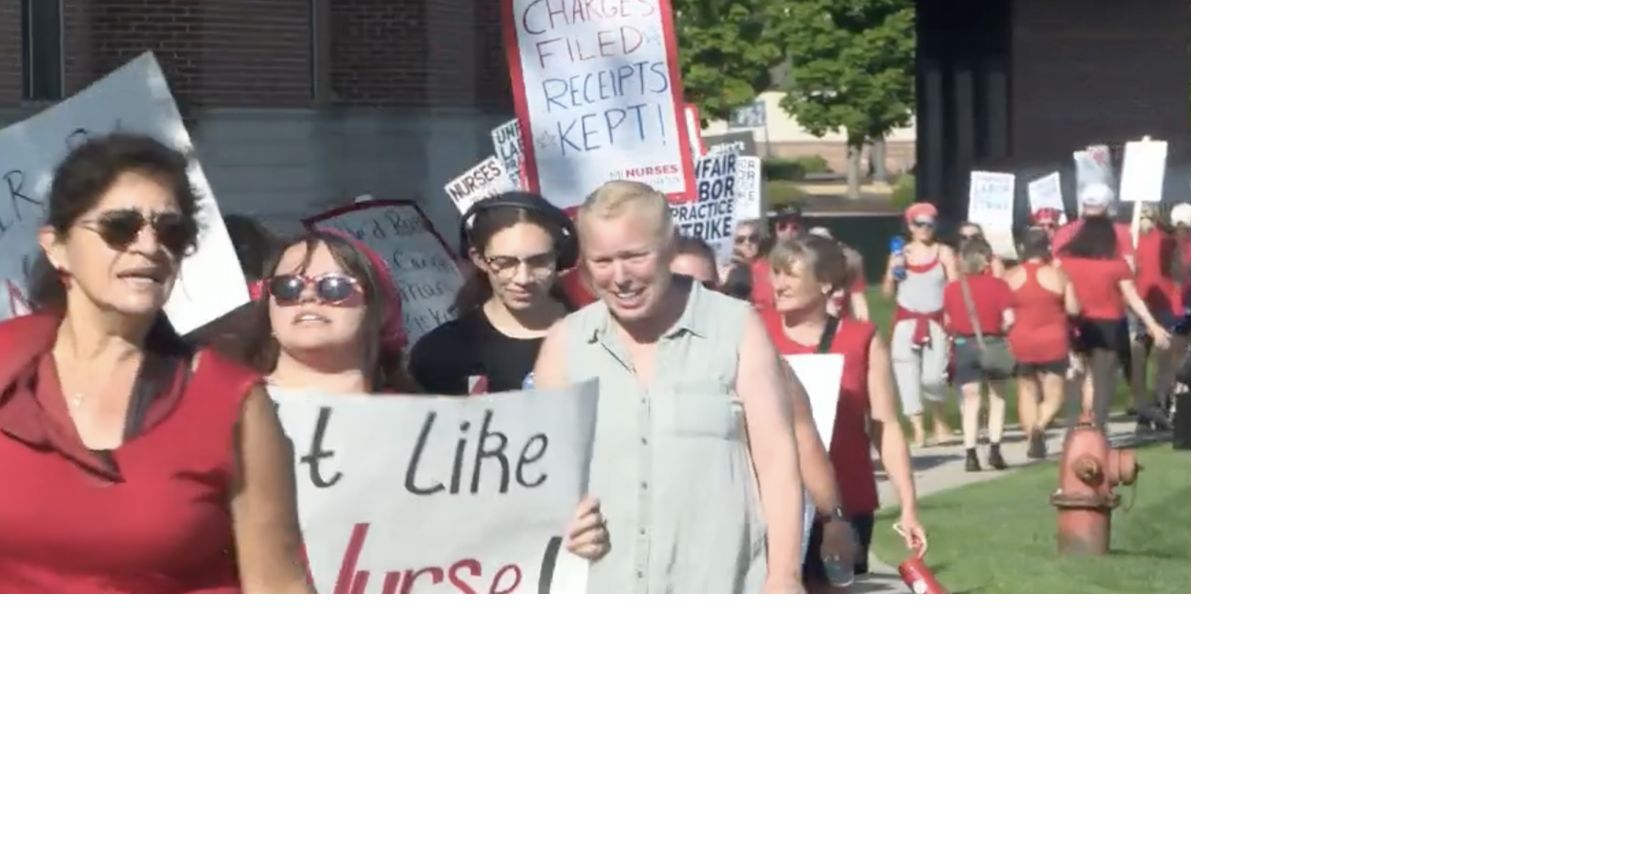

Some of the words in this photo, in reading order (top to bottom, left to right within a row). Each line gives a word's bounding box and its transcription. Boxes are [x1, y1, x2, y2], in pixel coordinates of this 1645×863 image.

[522, 0, 655, 35] CHARGES
[535, 26, 644, 69] FILED
[541, 61, 669, 114] RECEIPTS
[555, 103, 667, 157] KEPT!
[448, 160, 501, 203] NURSES
[625, 164, 679, 179] NURSES
[669, 198, 734, 222] PRACTICE
[404, 408, 549, 497] Like
